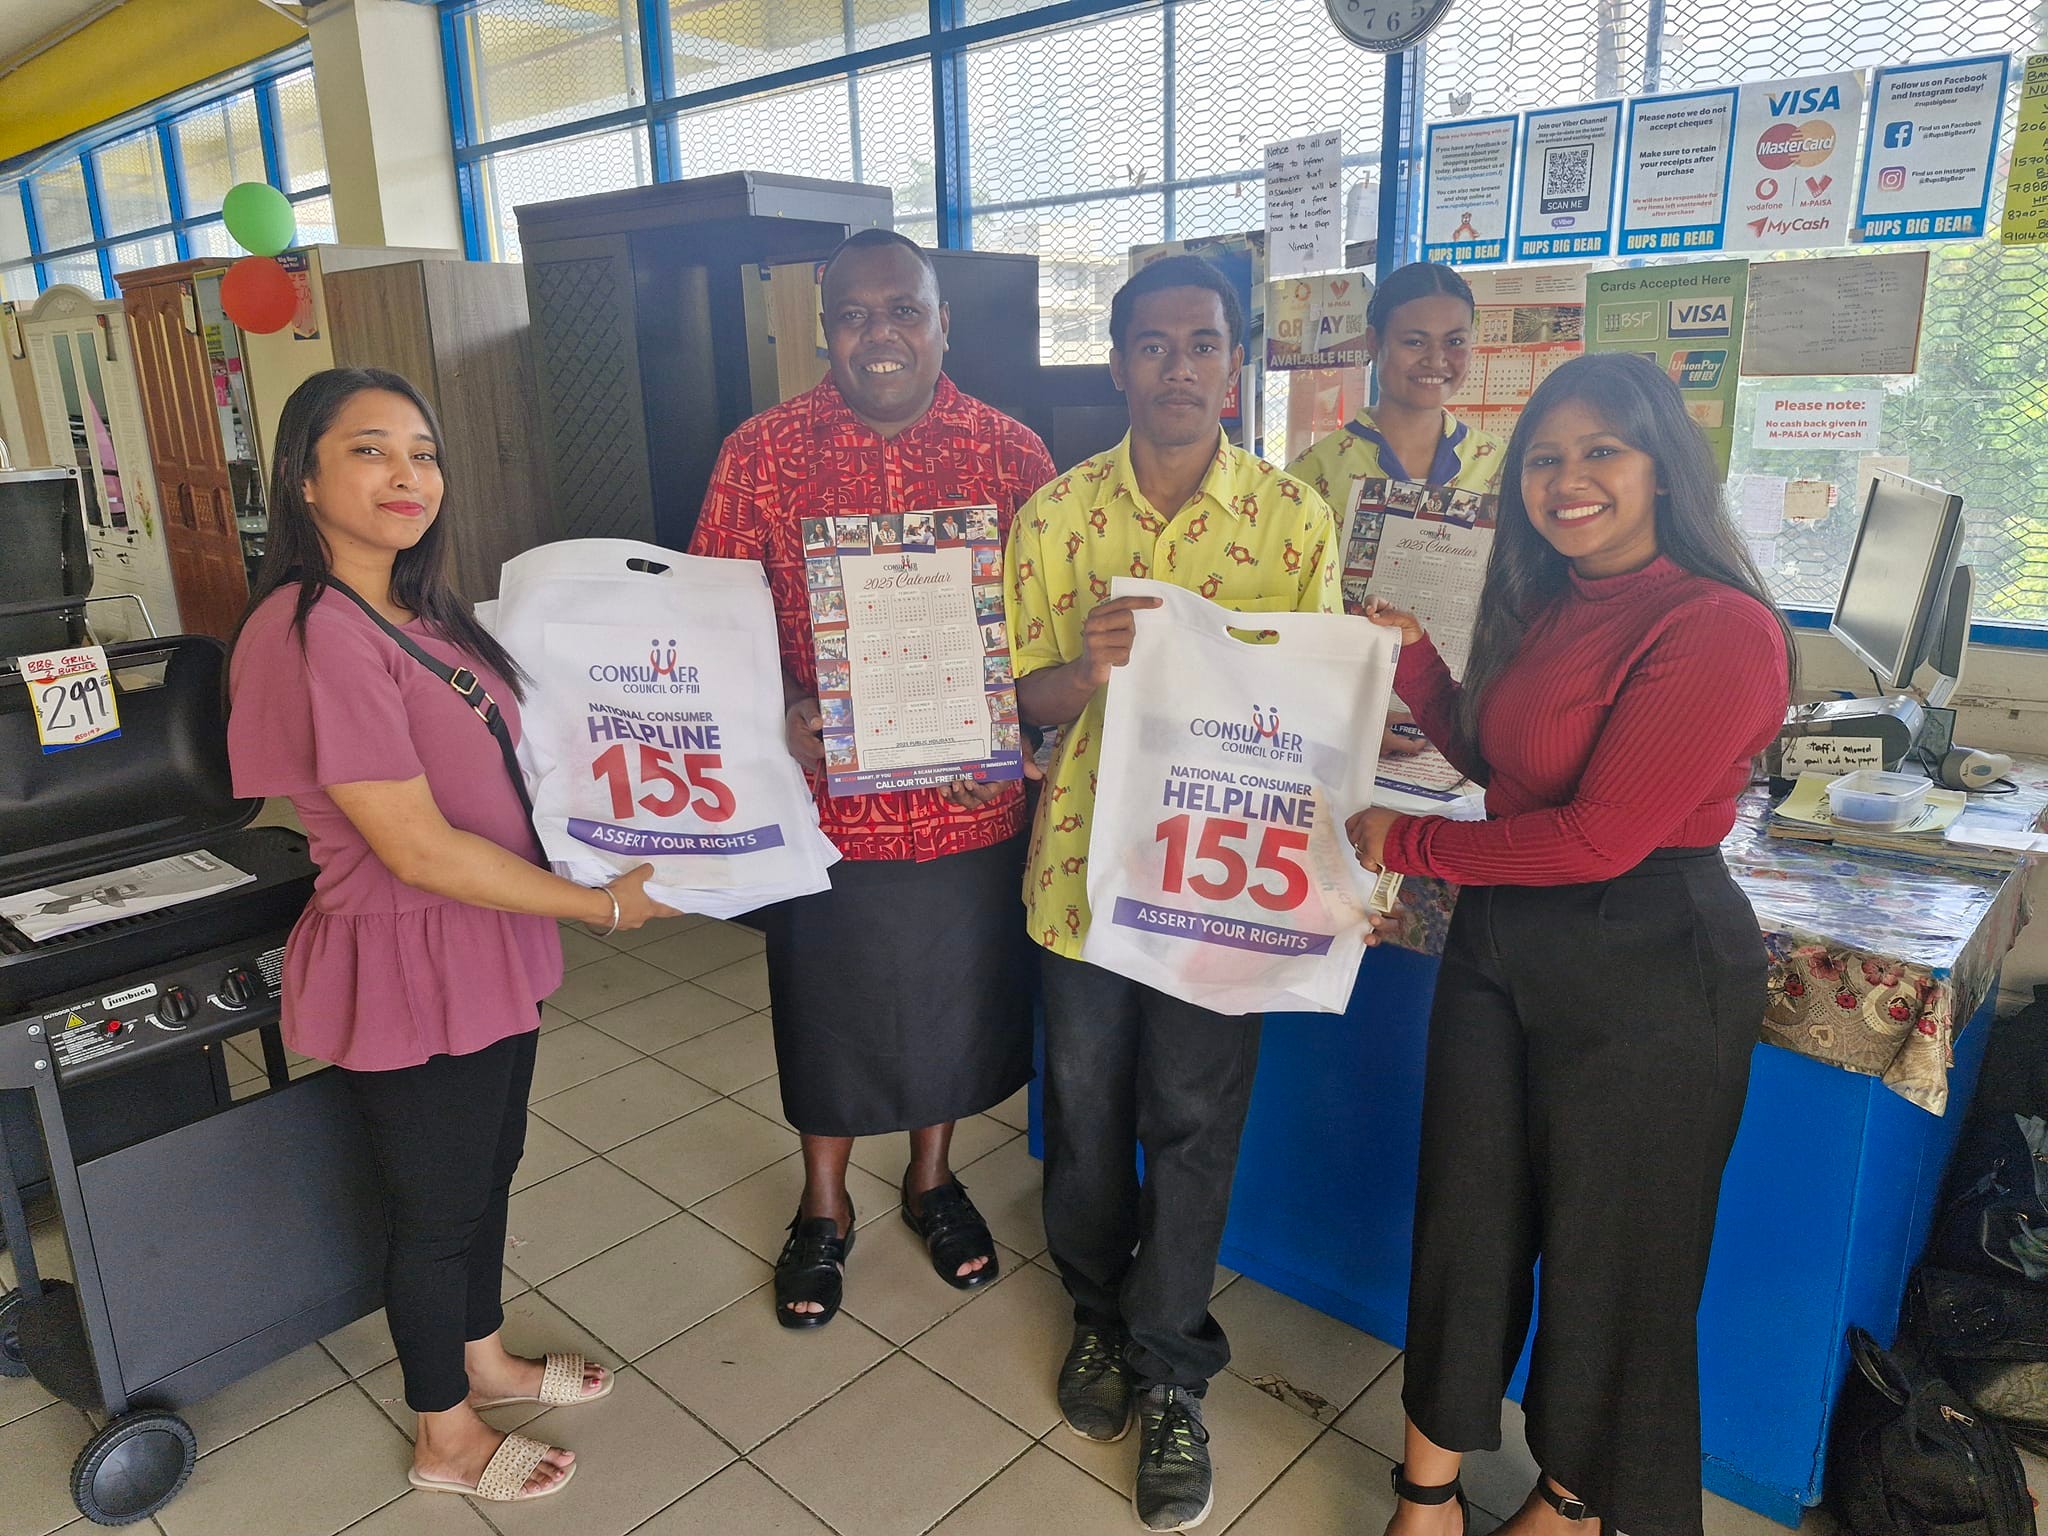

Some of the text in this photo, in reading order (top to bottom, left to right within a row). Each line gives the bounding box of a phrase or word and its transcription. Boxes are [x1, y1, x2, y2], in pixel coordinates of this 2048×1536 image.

[1363, 8, 1376, 29] 7
[1387, 11, 1400, 32] 6
[1890, 82, 1919, 91] Follow
[1944, 73, 1988, 85] Facebook
[1891, 83, 1985, 100] and Instagram today!
[1762, 85, 1841, 117] VISA
[1579, 116, 1608, 125] Channel!
[1639, 114, 1665, 122] Please
[1666, 111, 1686, 119] note
[1699, 107, 1711, 115] do
[1712, 106, 1727, 114] not
[1649, 119, 1713, 132] accept cheques
[1950, 120, 1982, 129] Facebook
[1296, 143, 1306, 151] to
[1310, 139, 1320, 149] all
[1451, 144, 1464, 152] have
[1475, 141, 1500, 149] feedback
[1639, 150, 1661, 159] Make
[1662, 149, 1680, 157] sure
[1691, 144, 1717, 154] retain
[1758, 135, 1834, 155] MasterCard
[1442, 151, 1470, 159] comments
[1468, 156, 1498, 164] experience
[1640, 155, 1715, 170] your receipts after
[1656, 167, 1695, 178] purchase
[1943, 166, 1976, 175] Instagram
[1547, 199, 1583, 210] SCAN ME
[1672, 193, 1708, 201] responsible
[1746, 202, 1783, 211] vodafone
[1767, 217, 1830, 235] MyCash
[1865, 215, 1973, 237] RUPS BIG BEAR
[1522, 237, 1602, 255] RUPS BIG BEAR
[1627, 230, 1715, 249] RUPS BIG BEAR
[1456, 246, 1472, 260] BIG
[1474, 244, 1500, 259] BEAR
[1600, 274, 1731, 292] Cards Accepted Here
[1621, 311, 1652, 328] BSP
[1678, 304, 1727, 323] VISA
[1270, 349, 1370, 368] AVAILABLE HERE
[1671, 359, 1721, 375] UnionPay
[1774, 400, 1866, 411] Please note:
[1766, 419, 1867, 429] No cash back given in
[1822, 431, 1862, 440] MyCash
[1396, 538, 1424, 552] 2025
[863, 571, 952, 590] 2025 Calendar
[27, 655, 93, 673] BBQ GRILL
[58, 663, 97, 675] BURNER
[589, 651, 699, 683] CONSUMER
[623, 684, 667, 694] COUNCIL
[669, 684, 684, 694] OF
[588, 703, 713, 722] NATIONAL CONSUMER
[587, 716, 721, 750] HELPLINE
[1190, 713, 1303, 752] CONSUMER
[1399, 725, 1417, 735] FREE
[1221, 741, 1303, 763] COUNCIL OF FIJI
[986, 760, 1018, 768] IMMEDIATELY
[591, 744, 736, 823] 155
[876, 772, 973, 789] CALL OUR TOLL FREE LINE
[1170, 765, 1313, 796] NATIONAL CONSUMER
[1162, 779, 1316, 829] HELPLINE
[591, 826, 757, 849] ASSERT YOUR RIGHTS
[1155, 813, 1309, 912] 155
[1137, 907, 1309, 949] ASSERT YOUR RIGHTS
[108, 988, 152, 1006] jumbuck
[43, 1009, 70, 1020] OUTDOOR
[82, 1000, 96, 1008] ONLY
